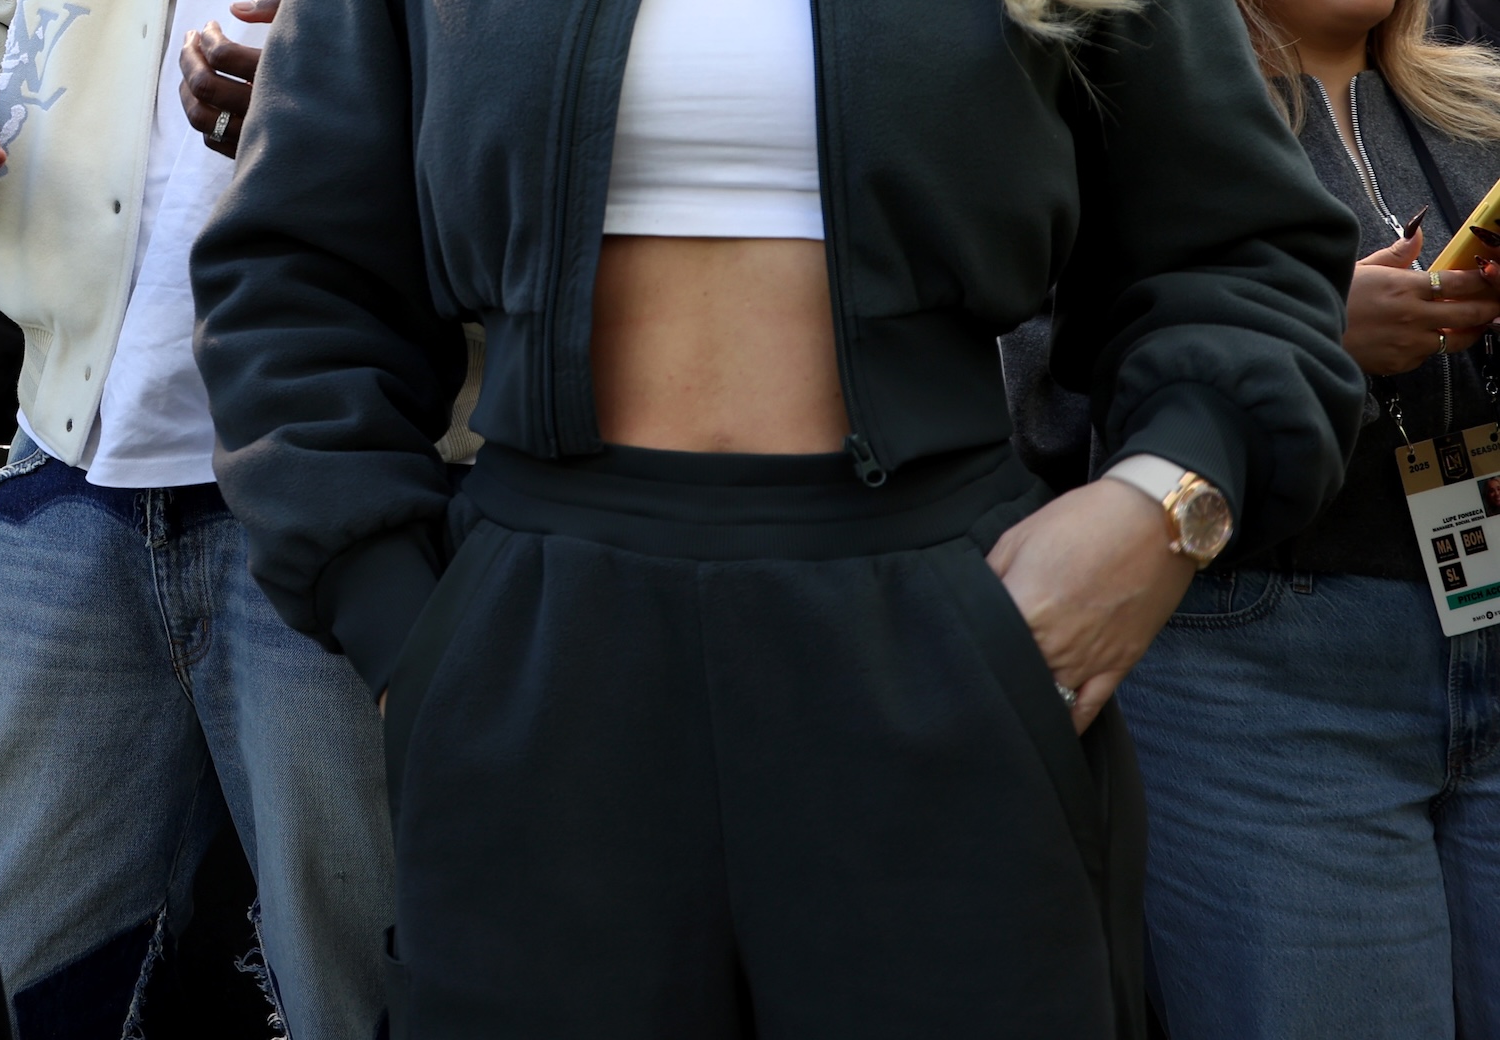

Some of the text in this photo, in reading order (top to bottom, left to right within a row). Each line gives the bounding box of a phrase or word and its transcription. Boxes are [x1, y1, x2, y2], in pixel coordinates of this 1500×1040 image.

[1409, 461, 1430, 473] 2025
[1443, 508, 1484, 524] LUPE FONSECA
[1462, 529, 1485, 548] BOH
[1436, 538, 1453, 555] MA
[1445, 567, 1460, 582] SL
[1457, 591, 1484, 604] PITCH
